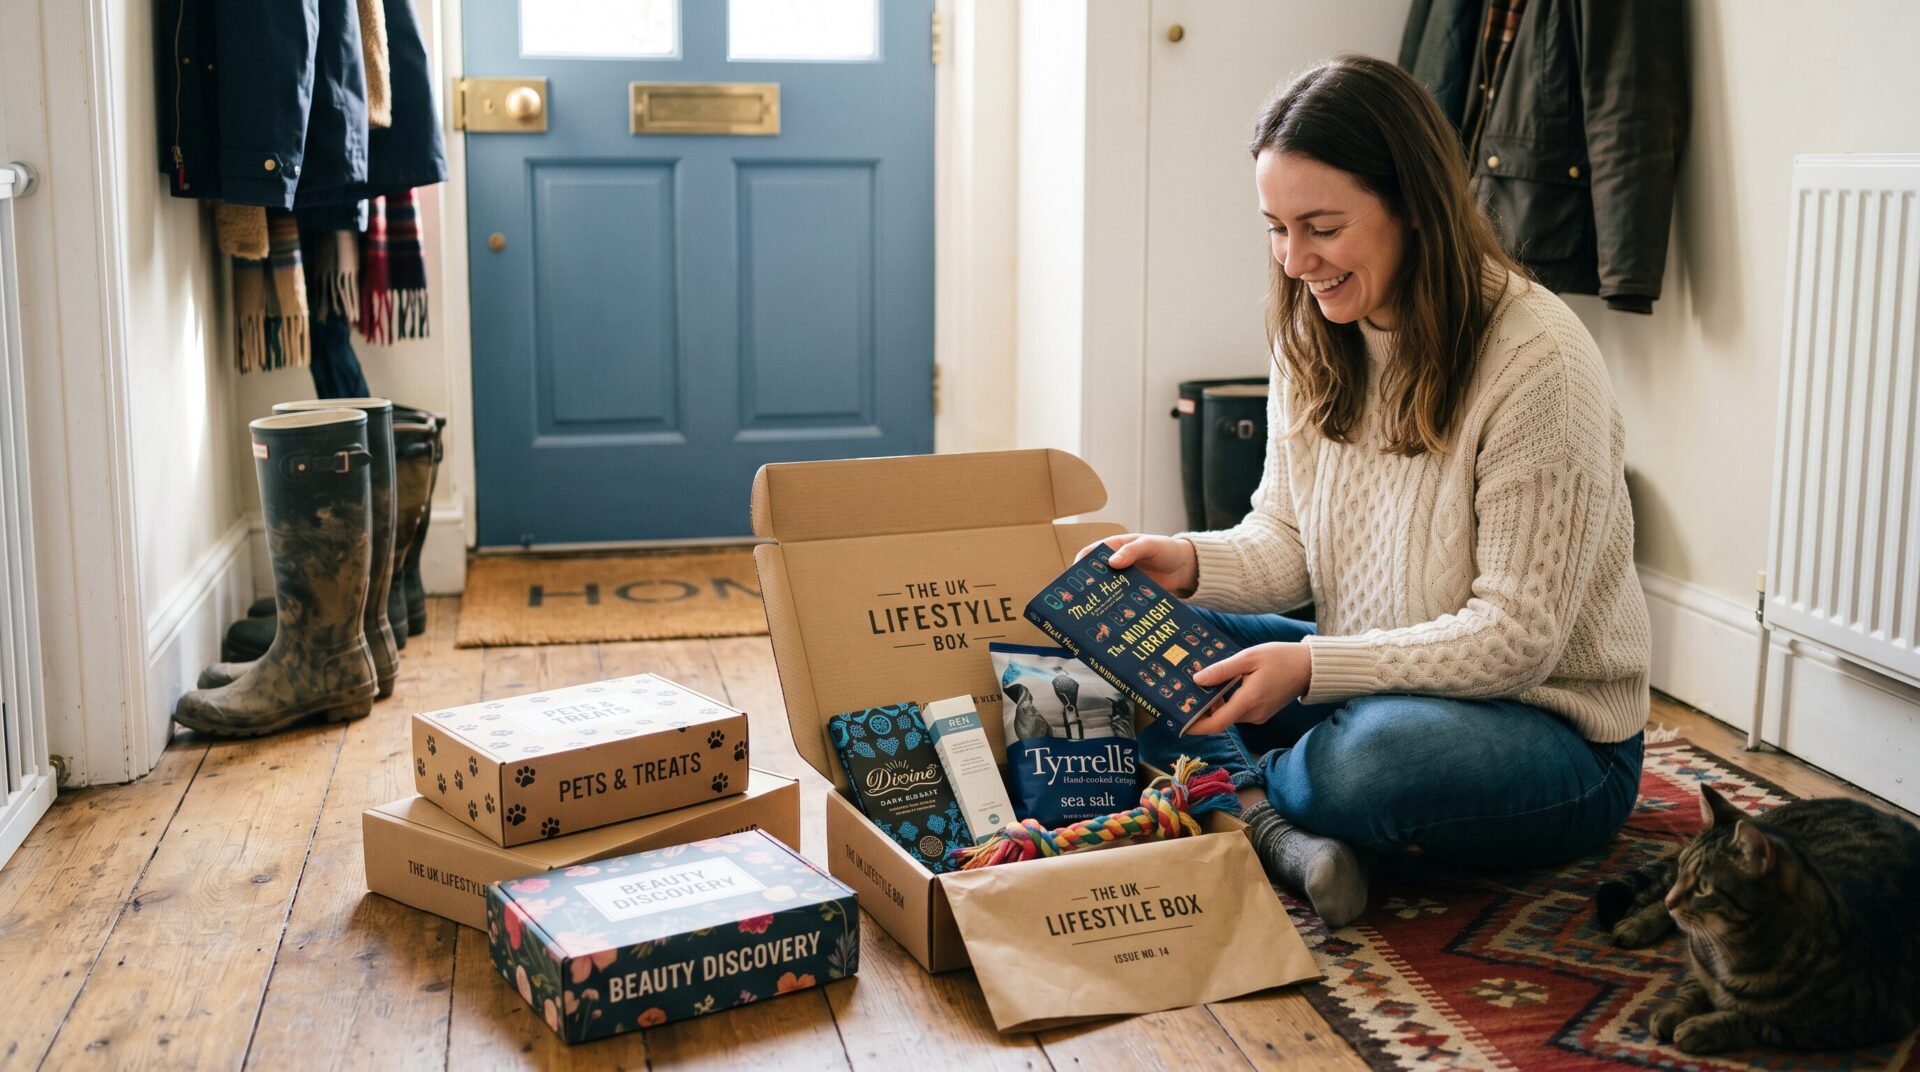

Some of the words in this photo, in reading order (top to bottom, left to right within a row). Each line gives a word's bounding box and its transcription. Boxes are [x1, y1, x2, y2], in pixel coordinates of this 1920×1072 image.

[905, 582, 940, 599] THE
[945, 579, 969, 595] UK
[1068, 592, 1101, 620] Matt
[1099, 574, 1130, 596] Haig
[868, 597, 1017, 634] LIFESTYLE
[1107, 643, 1126, 657] The
[1121, 598, 1175, 645] MIDNIGHT
[933, 633, 969, 651] BOX
[1132, 618, 1180, 661] LIBRARY
[543, 703, 598, 718] PETS
[551, 706, 631, 725] TREATS
[948, 716, 970, 728] REN
[560, 772, 607, 803] PETS
[614, 768, 627, 790] &
[633, 752, 702, 785] TREATS
[866, 764, 937, 793] Divine
[880, 796, 903, 807] DARK
[1061, 796, 1085, 807] sea
[1089, 792, 1116, 806] salt
[408, 860, 424, 877] THE
[427, 866, 439, 882] UK
[619, 869, 705, 895] BEAUTY
[845, 844, 855, 864] THE
[863, 861, 891, 898] LIFESTYLE
[893, 888, 904, 909] BOX
[613, 876, 736, 910] DISCOVERY
[1090, 885, 1118, 902] THE
[1120, 882, 1140, 897] UK
[1045, 901, 1156, 936] LIFESTYLE
[1159, 894, 1203, 918] BOX
[609, 960, 695, 1003] BEAUTY
[703, 931, 821, 981] DISCOVERY
[1114, 951, 1140, 965] ISSUE
[1142, 948, 1157, 959] NO.
[1158, 946, 1169, 956] 14
